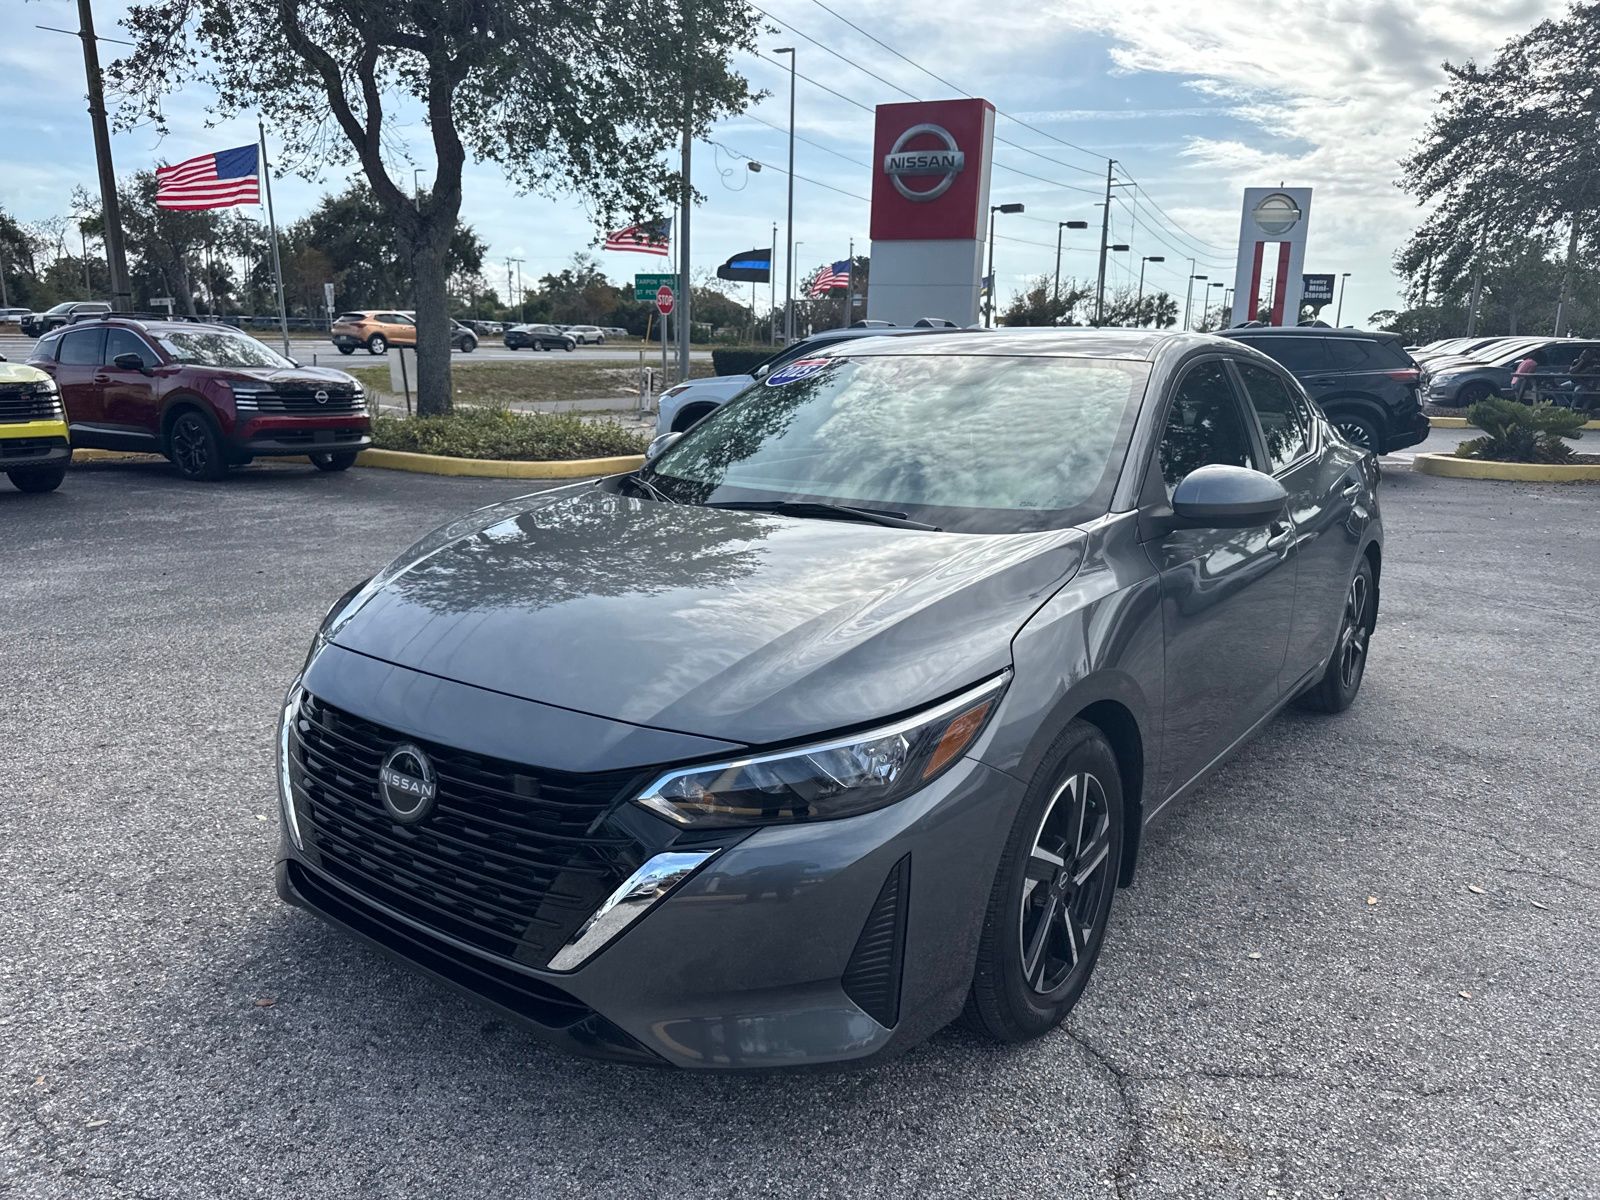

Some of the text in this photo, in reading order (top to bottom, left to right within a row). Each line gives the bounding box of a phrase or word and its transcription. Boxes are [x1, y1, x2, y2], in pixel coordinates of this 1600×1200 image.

[889, 155, 955, 169] NISSAN
[657, 295, 673, 306] STOP
[381, 768, 432, 796] NISSAN
